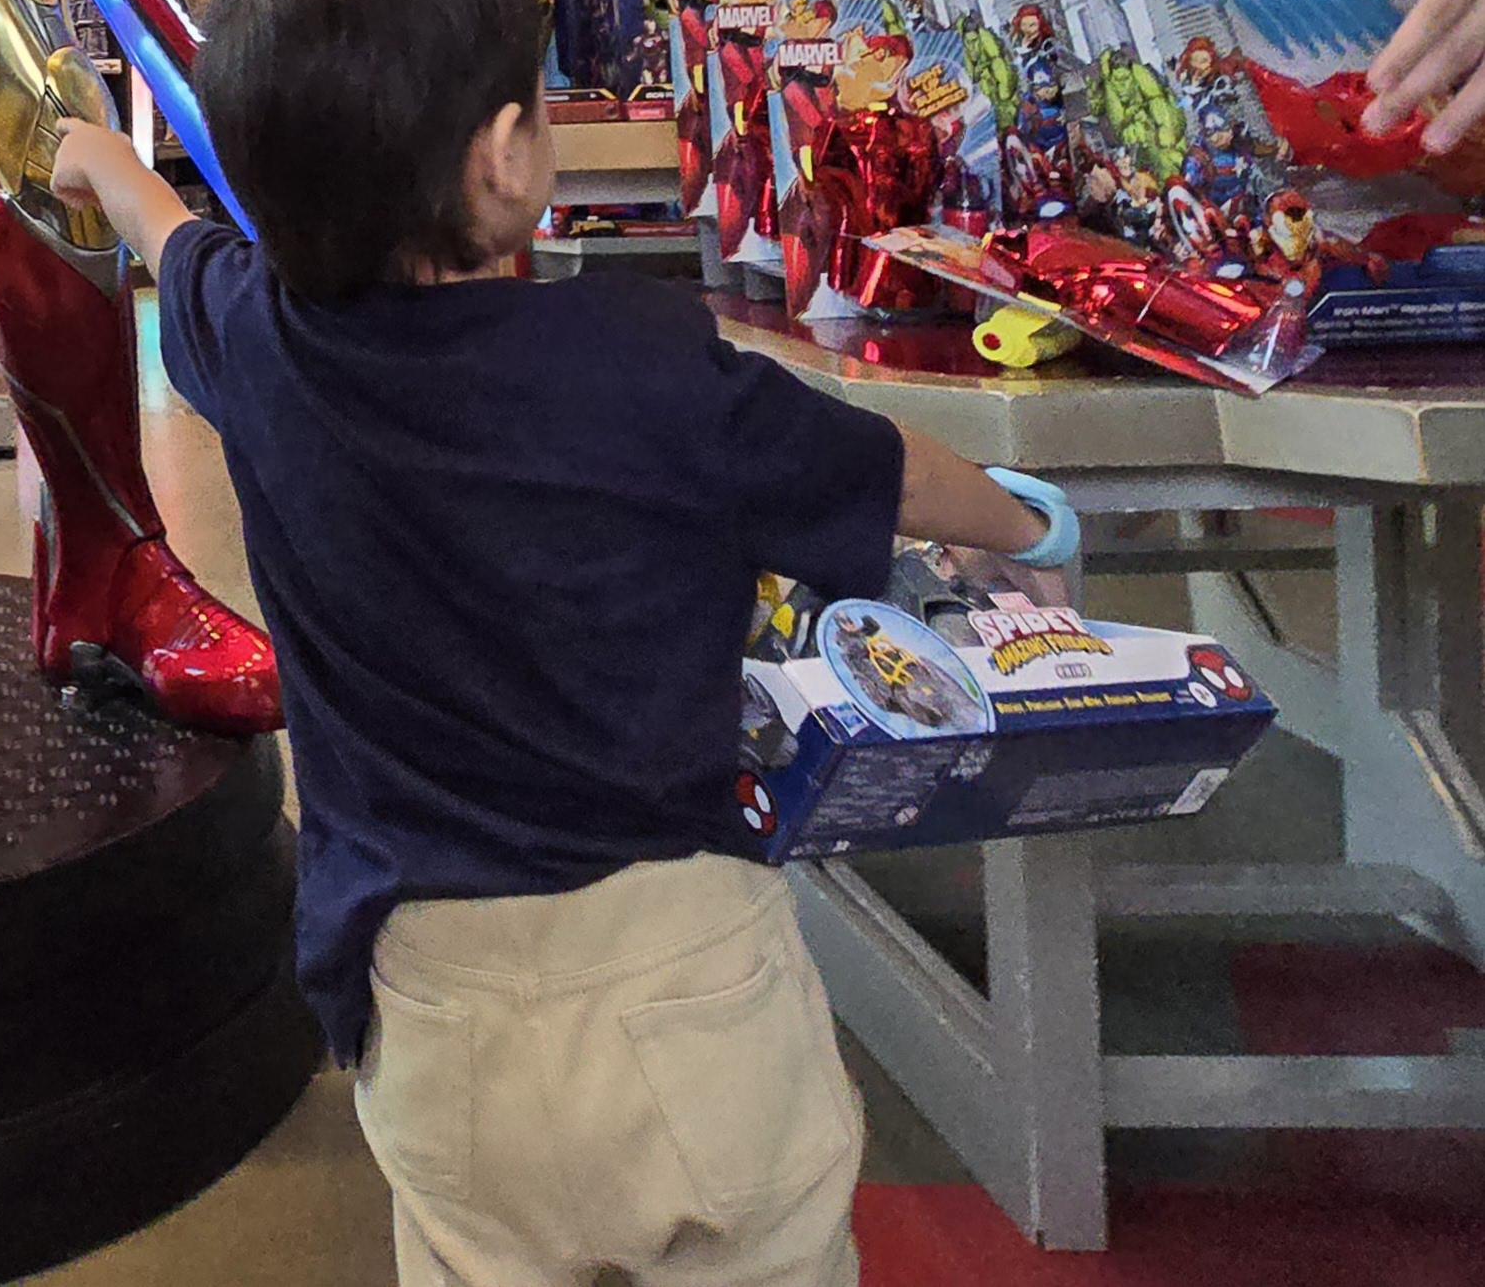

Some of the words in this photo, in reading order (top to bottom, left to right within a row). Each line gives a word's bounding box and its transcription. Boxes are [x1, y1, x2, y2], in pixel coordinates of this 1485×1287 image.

[718, 6, 773, 29] MARVEL
[779, 43, 842, 68] MARVEL
[972, 607, 1092, 650] SPIDEY
